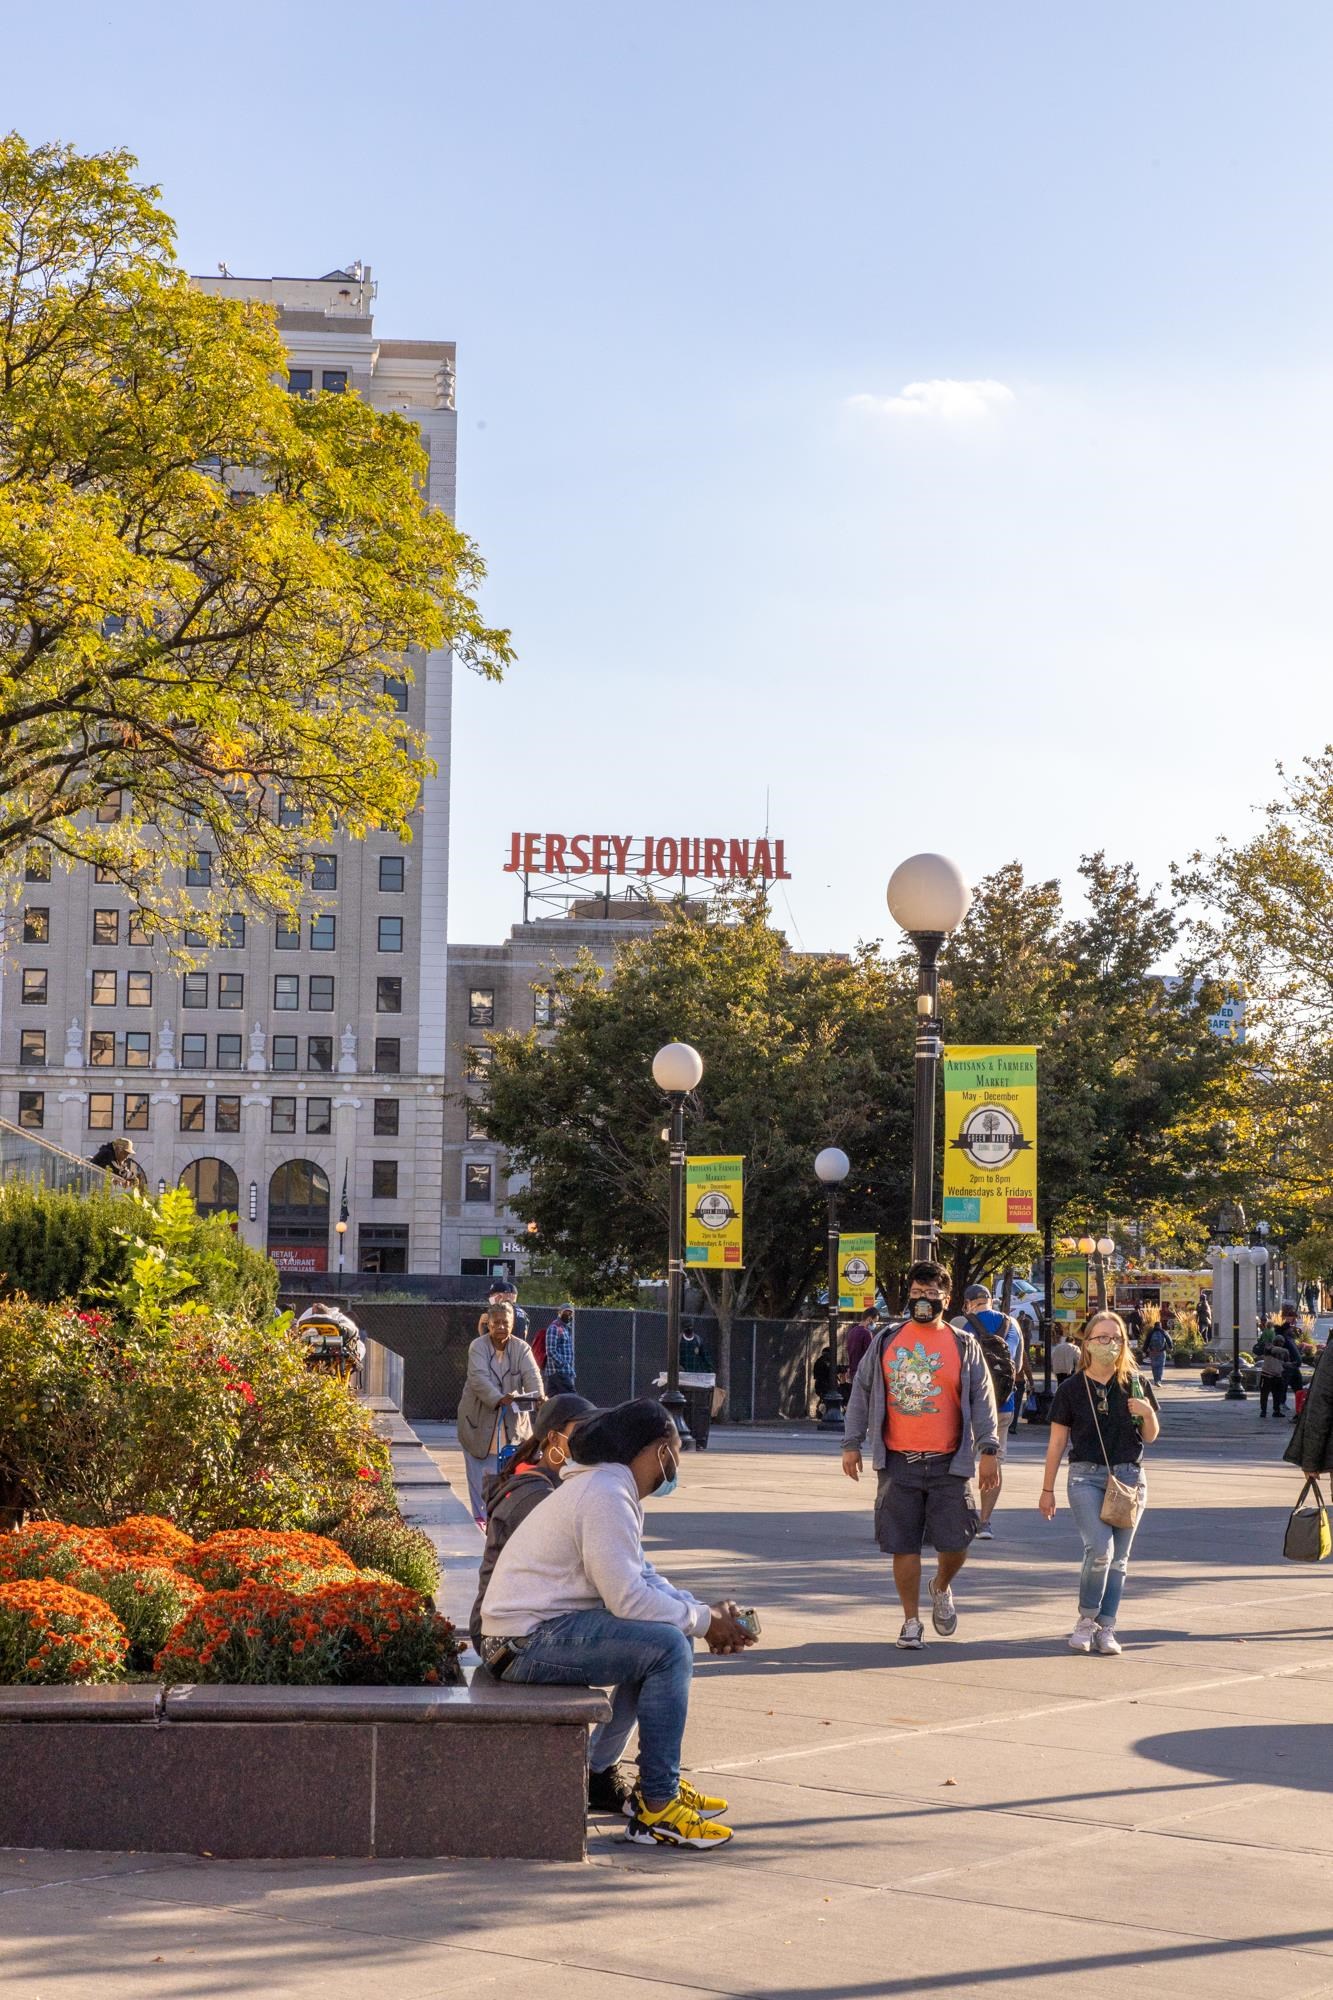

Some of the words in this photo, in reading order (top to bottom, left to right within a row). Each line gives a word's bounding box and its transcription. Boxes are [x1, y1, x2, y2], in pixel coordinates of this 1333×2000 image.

[503, 832, 633, 875] JERSEY
[636, 836, 792, 880] JOURNAL
[947, 1059, 986, 1071] ARTISANS
[988, 1062, 994, 1071] &
[997, 1059, 1034, 1071] FARMERS
[976, 1074, 1009, 1087] MARKET
[962, 1091, 977, 1101] May
[984, 1091, 1019, 1100] December
[970, 1174, 984, 1184] 2pm
[986, 1175, 993, 1183] to
[995, 1174, 1011, 1184] 8pm
[948, 1186, 995, 1198] Wednesdays
[996, 1187, 1002, 1196] &
[1005, 1187, 1033, 1198] Fridays
